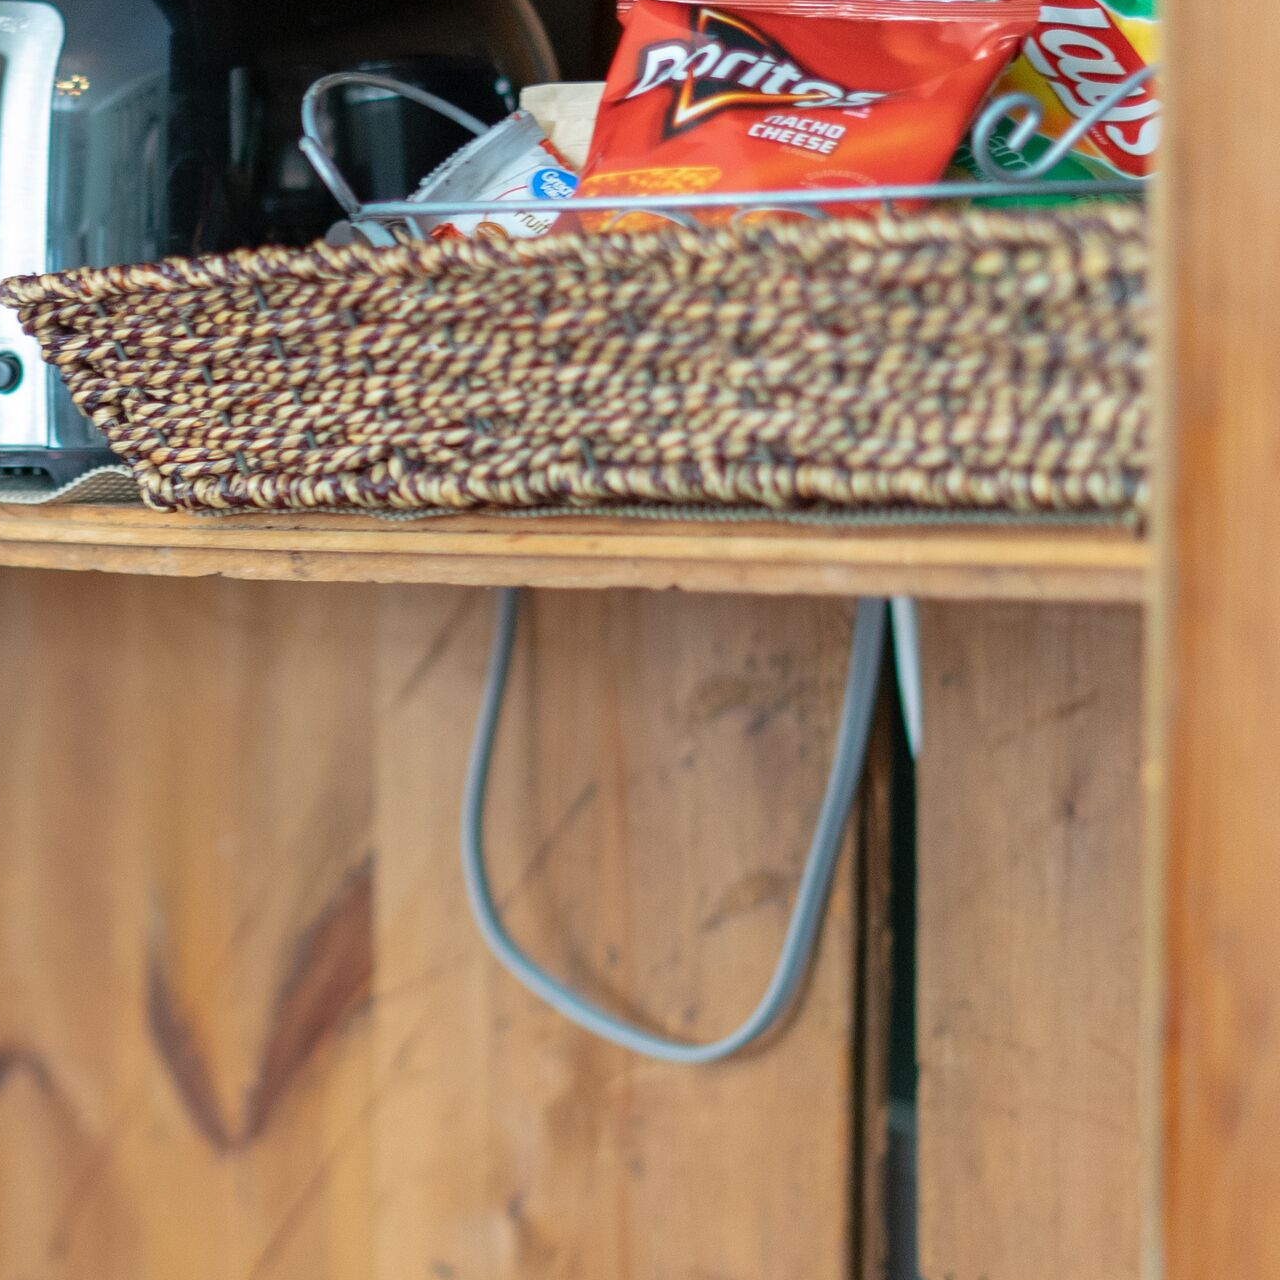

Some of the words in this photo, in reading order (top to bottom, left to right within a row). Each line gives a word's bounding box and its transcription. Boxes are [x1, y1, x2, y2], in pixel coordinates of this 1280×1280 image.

[626, 42, 888, 108] Doritos
[1023, 5, 1161, 156] Lays
[747, 124, 838, 154] CHEESE
[763, 114, 847, 139] NACHO
